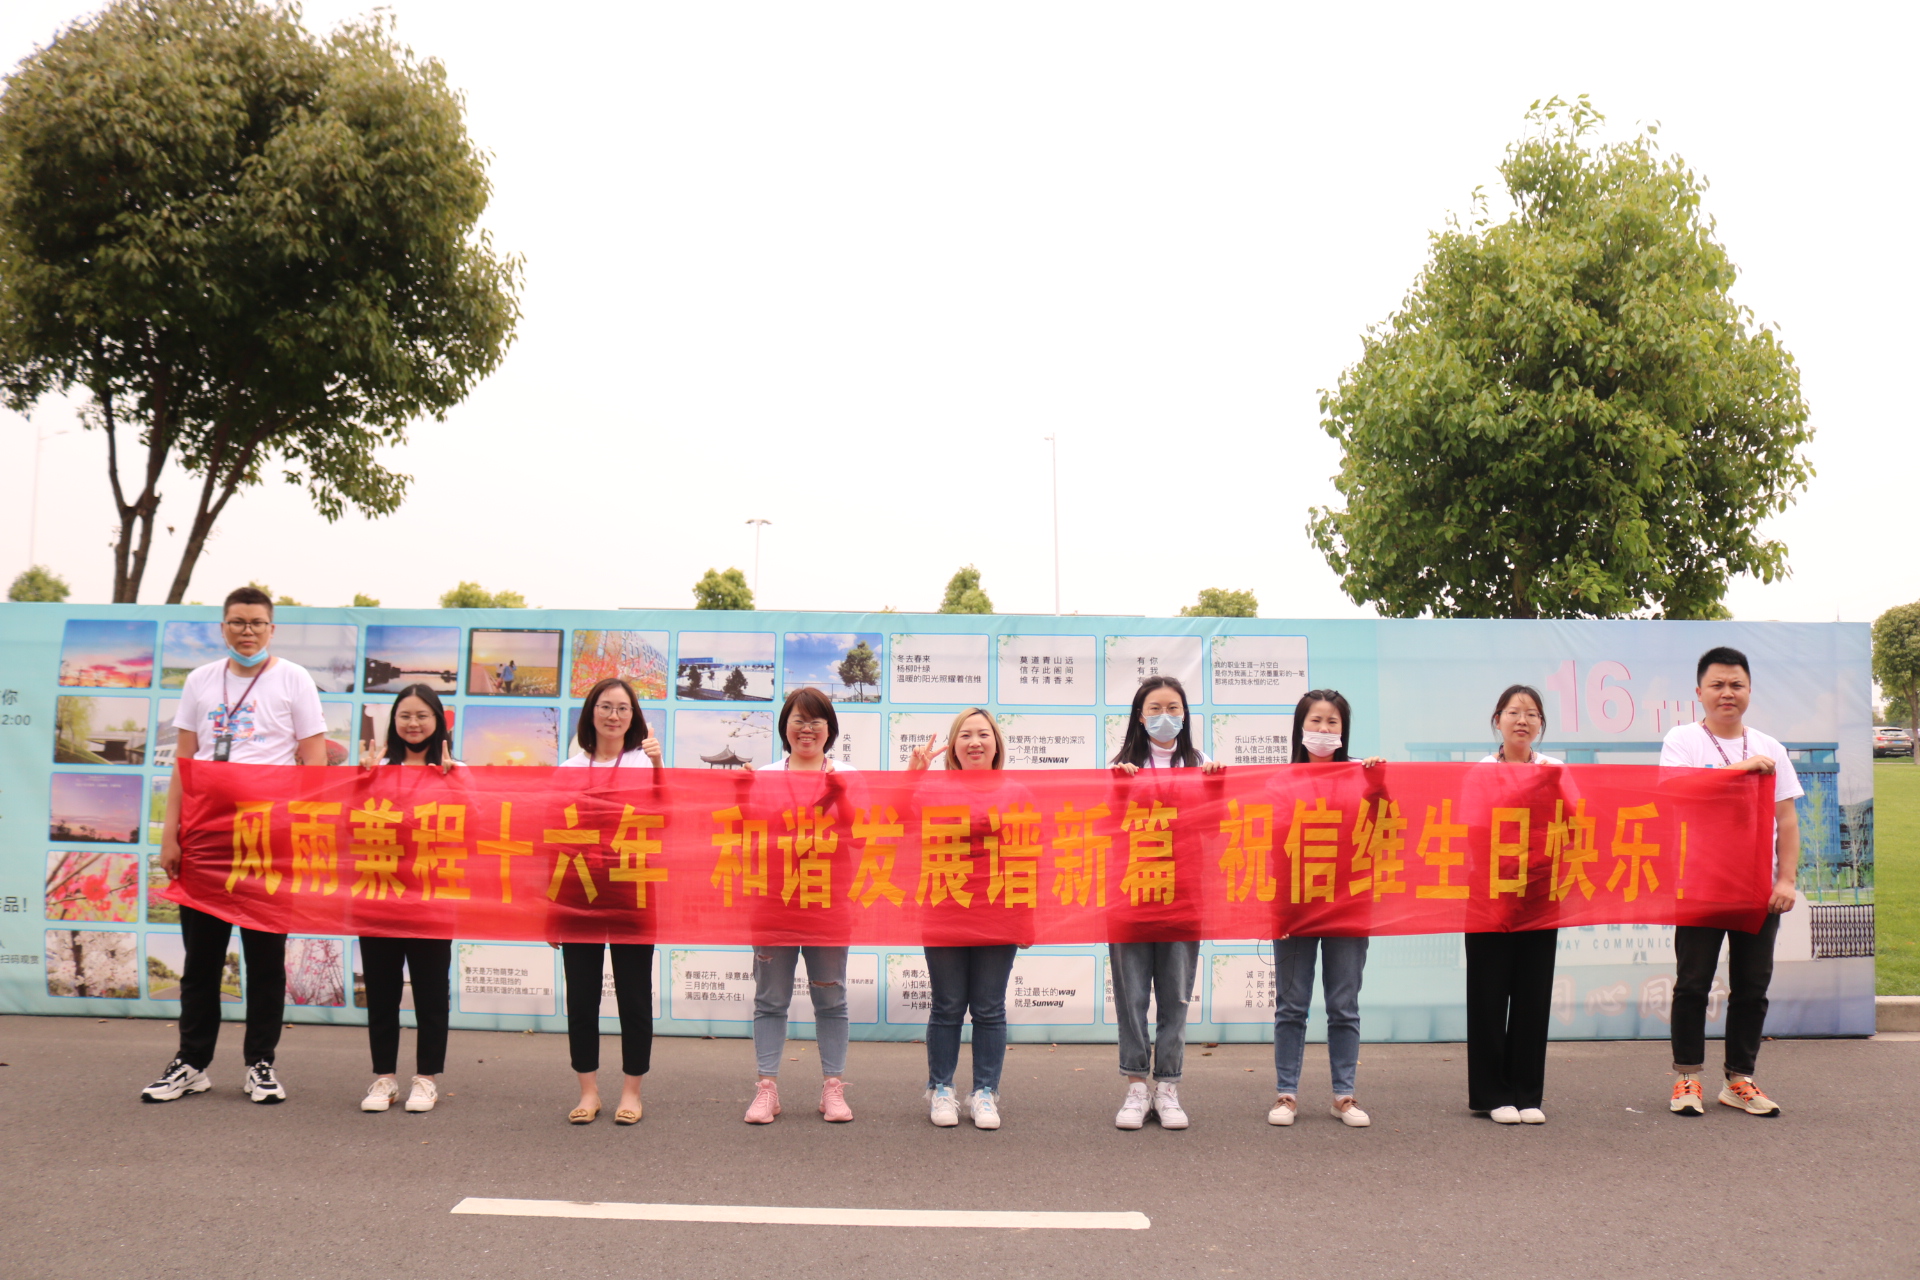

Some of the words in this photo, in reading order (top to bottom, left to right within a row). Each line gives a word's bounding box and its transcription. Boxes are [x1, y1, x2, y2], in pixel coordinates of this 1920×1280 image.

[897, 655, 931, 663] 冬去春来
[897, 665, 931, 673] 杨柳叶绿
[897, 675, 981, 683] 温暖的阳光照耀着信维
[1008, 736, 1085, 744] 我爱两个地方爱的深沉
[1008, 745, 1047, 754] 一个是信维
[225, 797, 668, 908] 风雨兼程十六年
[709, 800, 1178, 909] 和谐发展谱新篇
[465, 977, 521, 985] 生机是无法阻挡的
[1015, 976, 1023, 985] 我
[685, 982, 725, 990] 三月的信维
